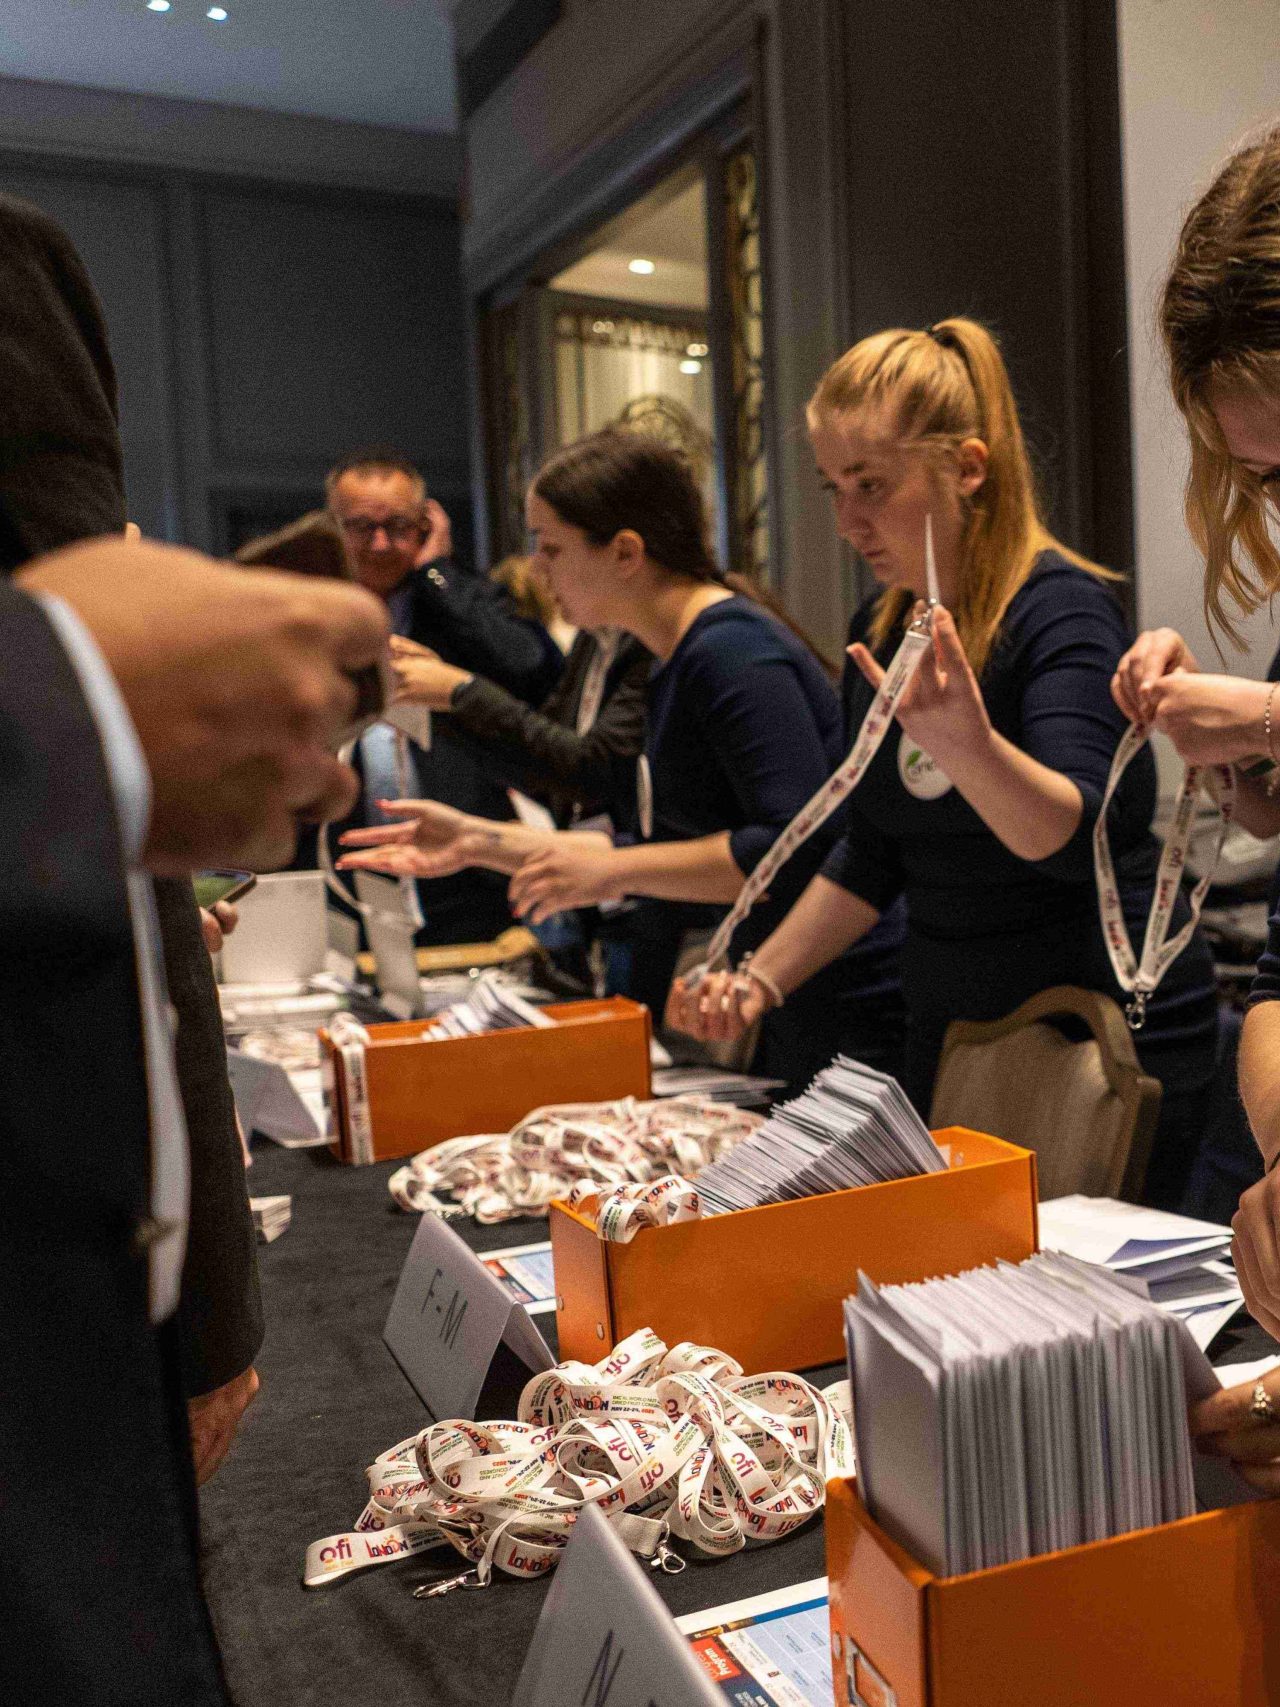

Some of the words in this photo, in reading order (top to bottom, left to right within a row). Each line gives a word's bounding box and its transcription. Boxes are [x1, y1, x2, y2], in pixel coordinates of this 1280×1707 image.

[608, 1437, 633, 1461] ofi
[640, 1462, 664, 1492] ofi
[730, 1452, 758, 1478] ofi
[320, 1536, 352, 1563] ofi
[365, 1538, 409, 1558] LONDON
